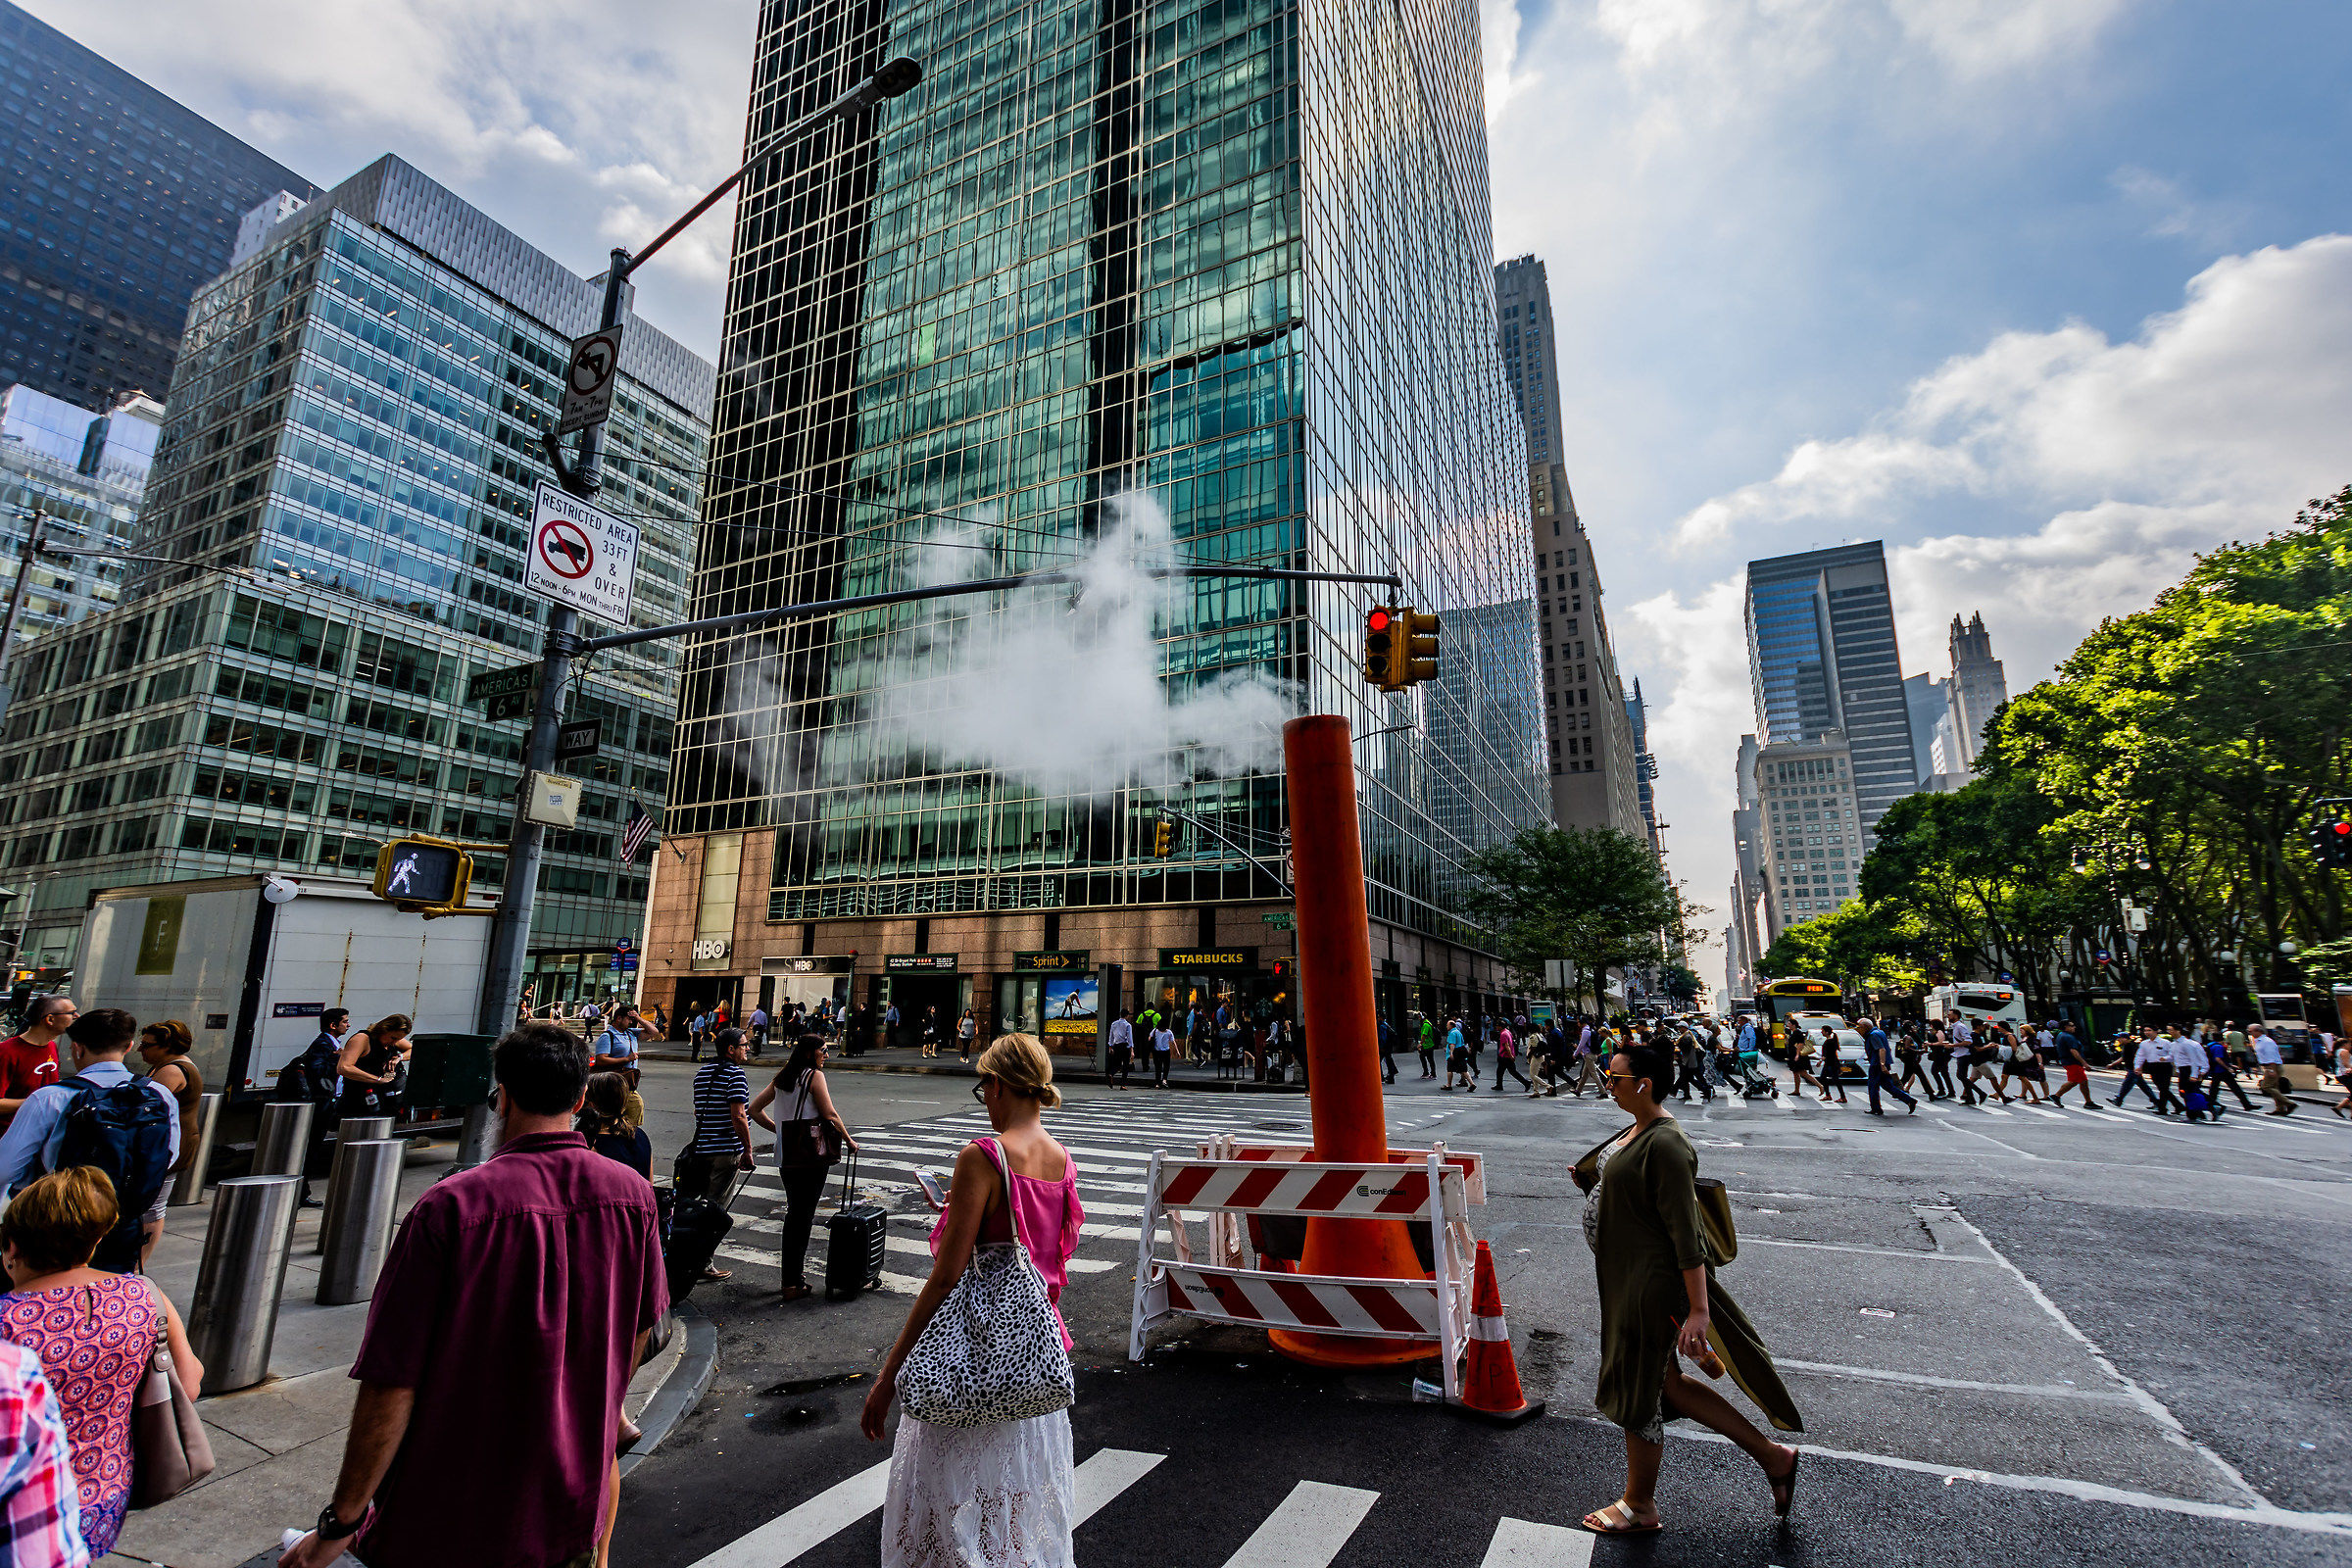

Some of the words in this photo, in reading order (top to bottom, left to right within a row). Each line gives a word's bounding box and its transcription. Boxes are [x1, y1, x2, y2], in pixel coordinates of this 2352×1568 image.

[542, 492, 602, 530] RESTRICTED
[607, 523, 633, 545] AREA
[609, 563, 617, 577] &
[530, 570, 540, 584] 12
[540, 579, 558, 591] NOON
[579, 590, 598, 606] MON
[599, 601, 612, 612] THRU
[612, 604, 624, 617] FRI
[595, 576, 625, 600] OVER
[471, 673, 529, 697] AMERICAS
[496, 698, 507, 716] 6
[692, 939, 726, 959] HBO
[795, 960, 813, 971] HBO
[1033, 956, 1058, 968] Sprint
[1172, 954, 1244, 964] STARBUCKS
